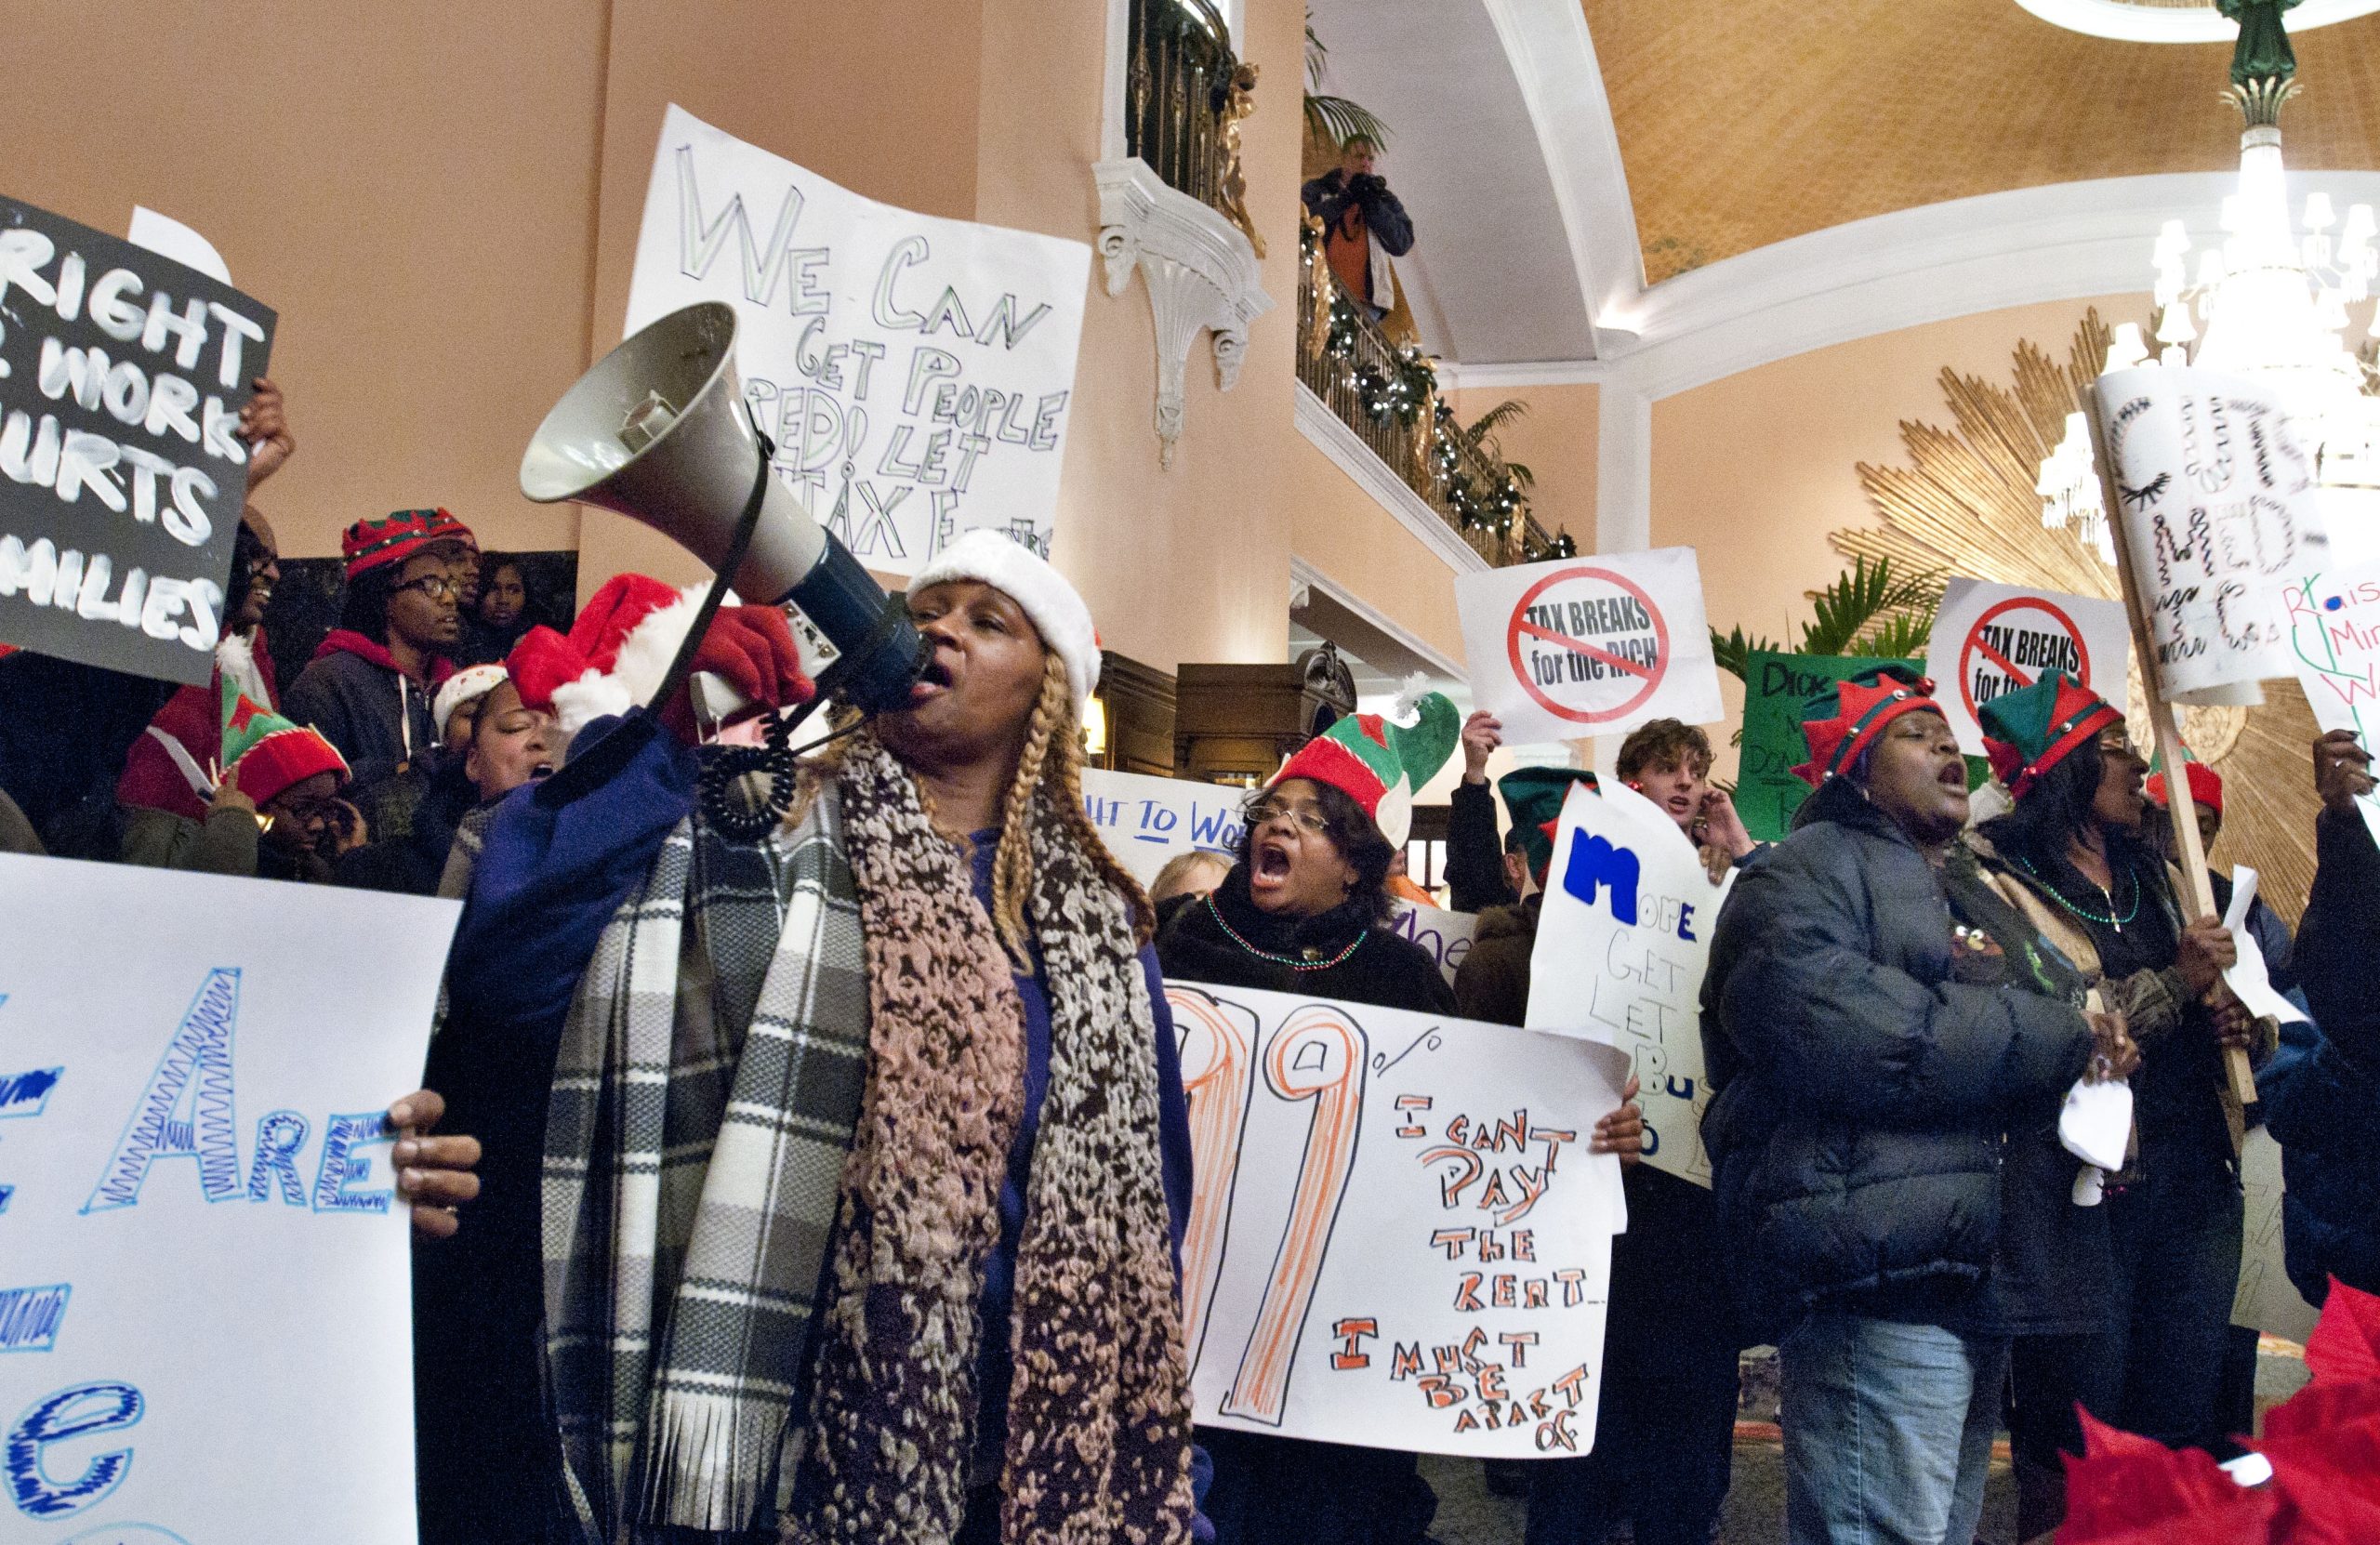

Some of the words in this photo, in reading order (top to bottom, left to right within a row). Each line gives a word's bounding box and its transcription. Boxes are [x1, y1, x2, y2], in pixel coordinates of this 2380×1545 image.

[676, 143, 831, 318] WE
[871, 235, 1052, 351] CAN
[0, 229, 265, 390] RIGHT
[38, 337, 246, 466] WORK
[796, 316, 886, 403] GET
[903, 347, 1069, 453] PEOPLE
[0, 409, 219, 548] URTS
[877, 425, 992, 494] LET
[1526, 603, 1567, 642] TAX
[1568, 596, 1651, 638] BREAKS
[1982, 625, 2014, 662] TAX
[2015, 629, 2079, 673] BREAKS
[1531, 649, 1564, 686] for
[1566, 640, 1605, 683] the
[1606, 637, 1658, 679] RICH
[1974, 667, 2001, 703] for
[1139, 800, 1178, 832] TO
[1607, 929, 1686, 993] GET
[1590, 974, 1679, 1044] LET
[78, 967, 403, 1216] ARE
[1395, 1094, 1434, 1138] I
[1416, 1144, 1551, 1228] PAY
[1331, 1318, 1380, 1371] I
[1391, 1327, 1540, 1381] MUST
[1417, 1364, 1511, 1409] BE
